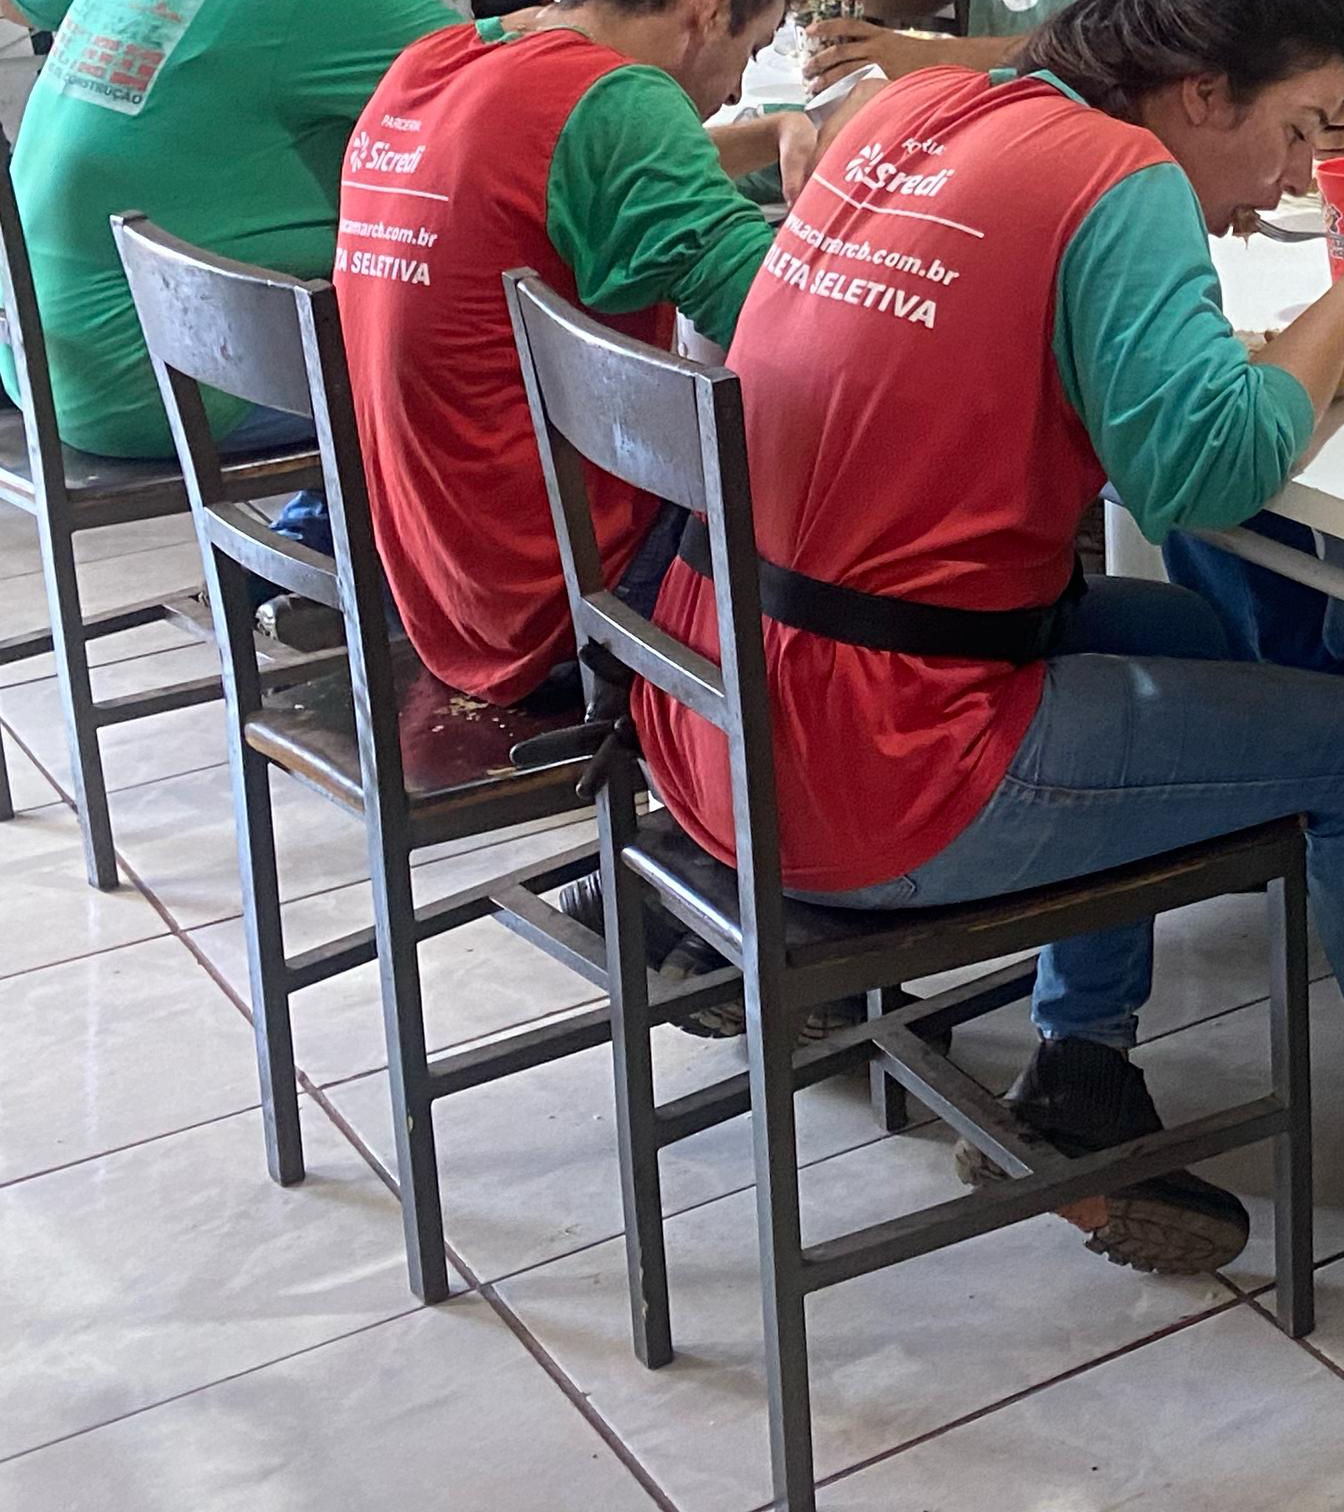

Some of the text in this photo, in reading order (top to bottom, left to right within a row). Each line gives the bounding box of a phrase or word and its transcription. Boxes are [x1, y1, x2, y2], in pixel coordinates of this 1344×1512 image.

[366, 140, 427, 174] Sicredi
[350, 250, 431, 286] SELETIVA
[810, 267, 937, 329] SELETIVA
